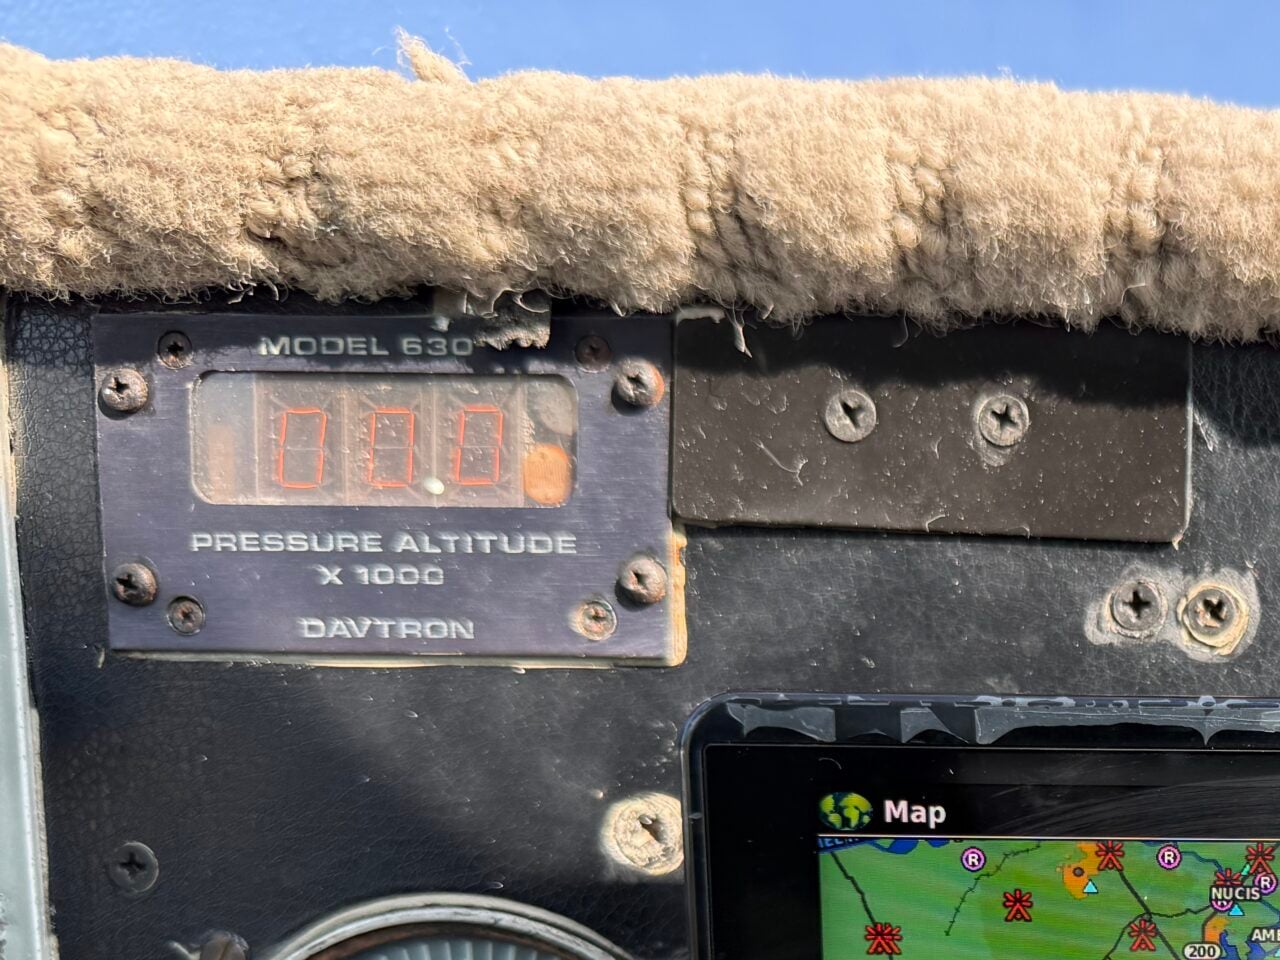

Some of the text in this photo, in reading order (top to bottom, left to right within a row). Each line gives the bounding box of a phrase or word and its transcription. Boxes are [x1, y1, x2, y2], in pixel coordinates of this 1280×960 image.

[259, 336, 475, 357] MODEL 630
[190, 533, 578, 555] PRESSURE ALTITUDE
[318, 565, 445, 586] X 1000
[301, 618, 475, 640] DAVTRON
[884, 800, 947, 828] Map
[1211, 888, 1260, 900] NUCIS
[1189, 945, 1216, 958] 200
